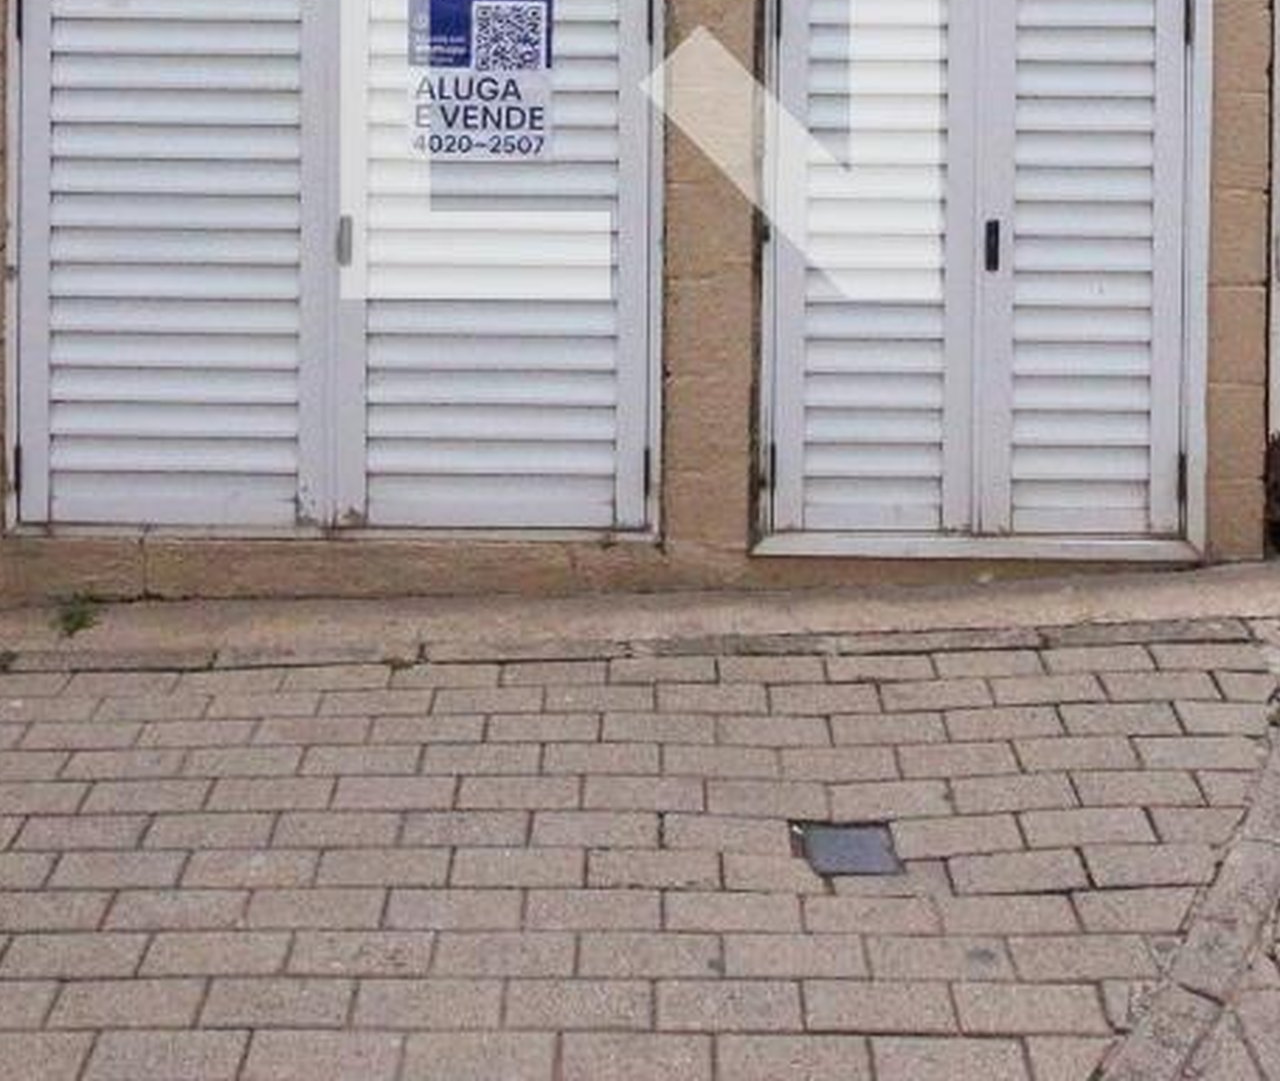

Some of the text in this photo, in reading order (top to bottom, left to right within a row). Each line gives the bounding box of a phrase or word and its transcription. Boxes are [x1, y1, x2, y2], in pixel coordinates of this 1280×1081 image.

[416, 76, 522, 102] ALUGA
[415, 104, 544, 131] E VENDE
[413, 134, 545, 155] 4020-2507
